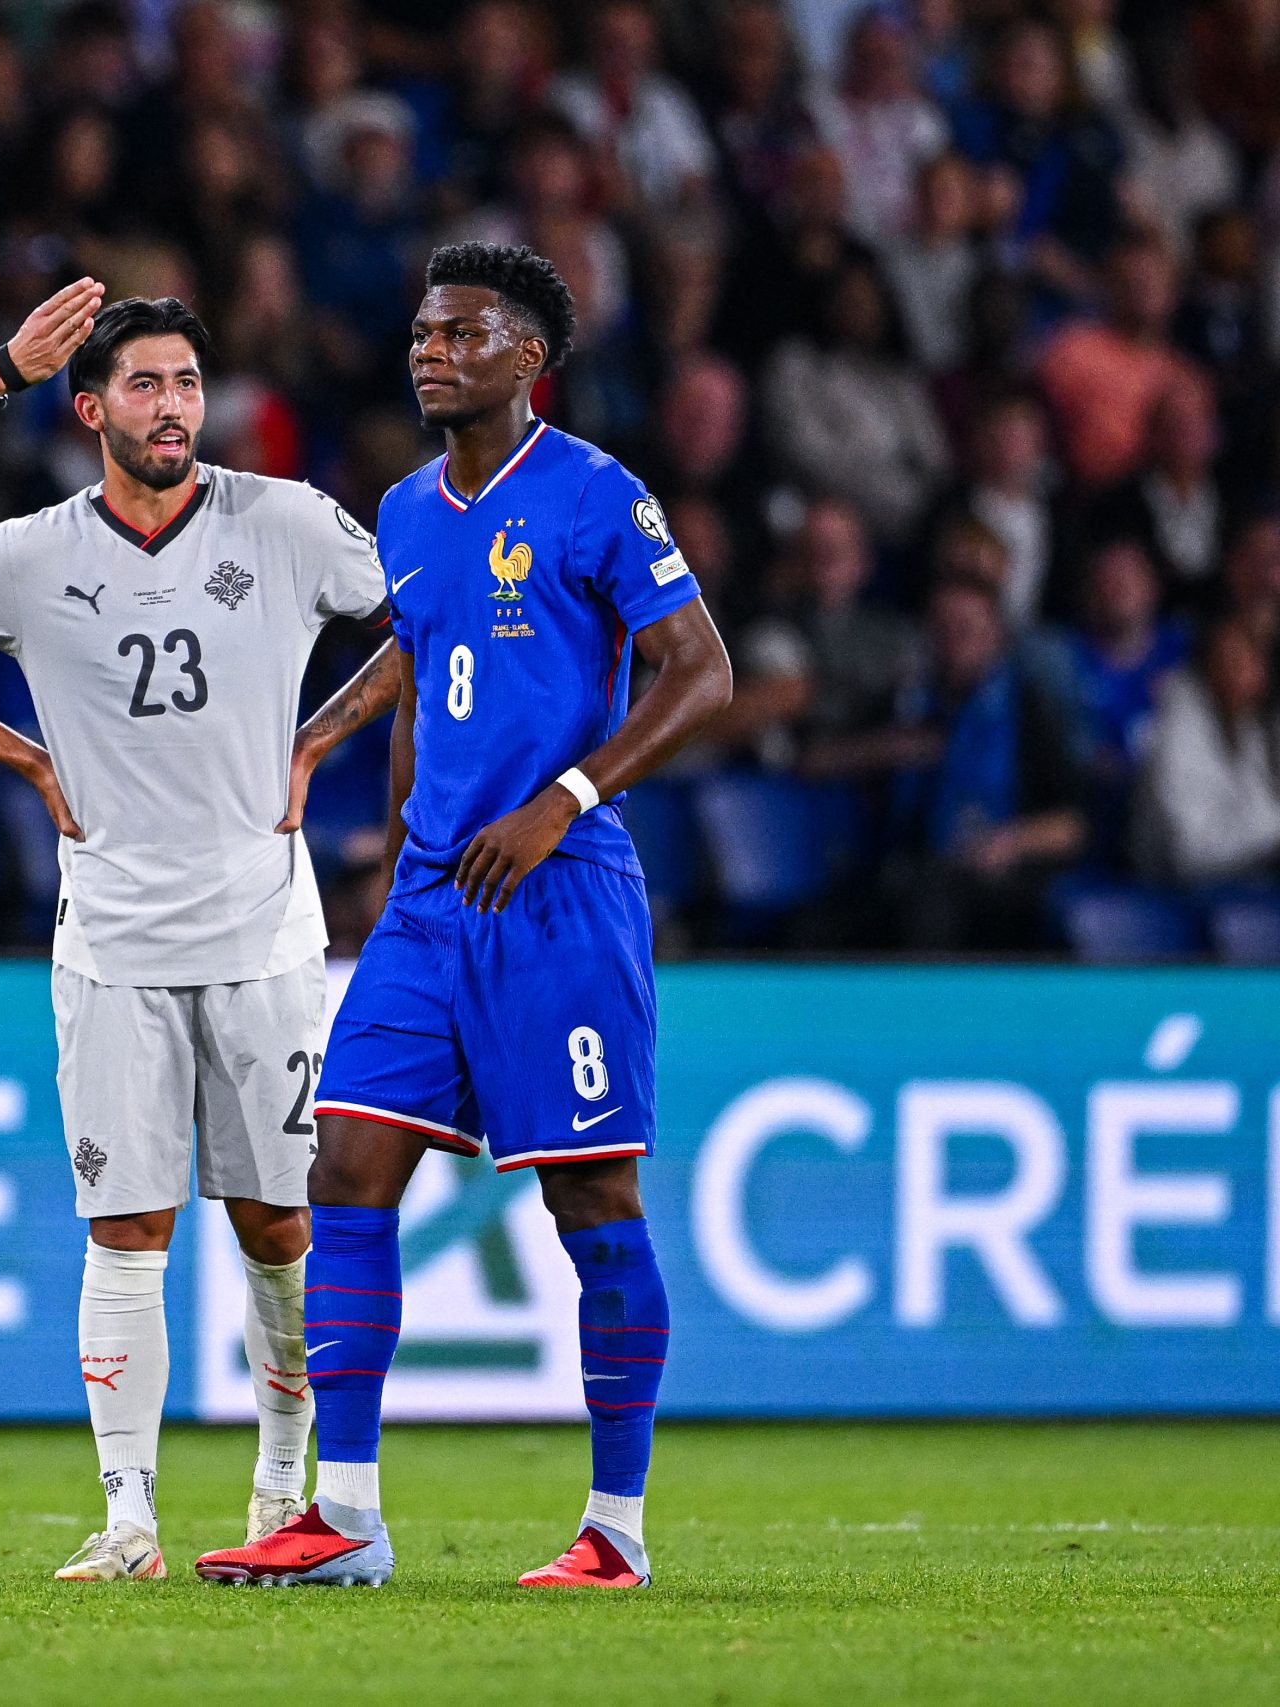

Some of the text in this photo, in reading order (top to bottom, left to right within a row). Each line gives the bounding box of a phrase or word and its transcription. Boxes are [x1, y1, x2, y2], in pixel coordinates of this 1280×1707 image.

[117, 628, 209, 718] 23
[447, 644, 475, 721] 8
[568, 1026, 609, 1102] 8
[689, 1012, 1280, 1333] CRÉ
[279, 1460, 295, 1470] 77
